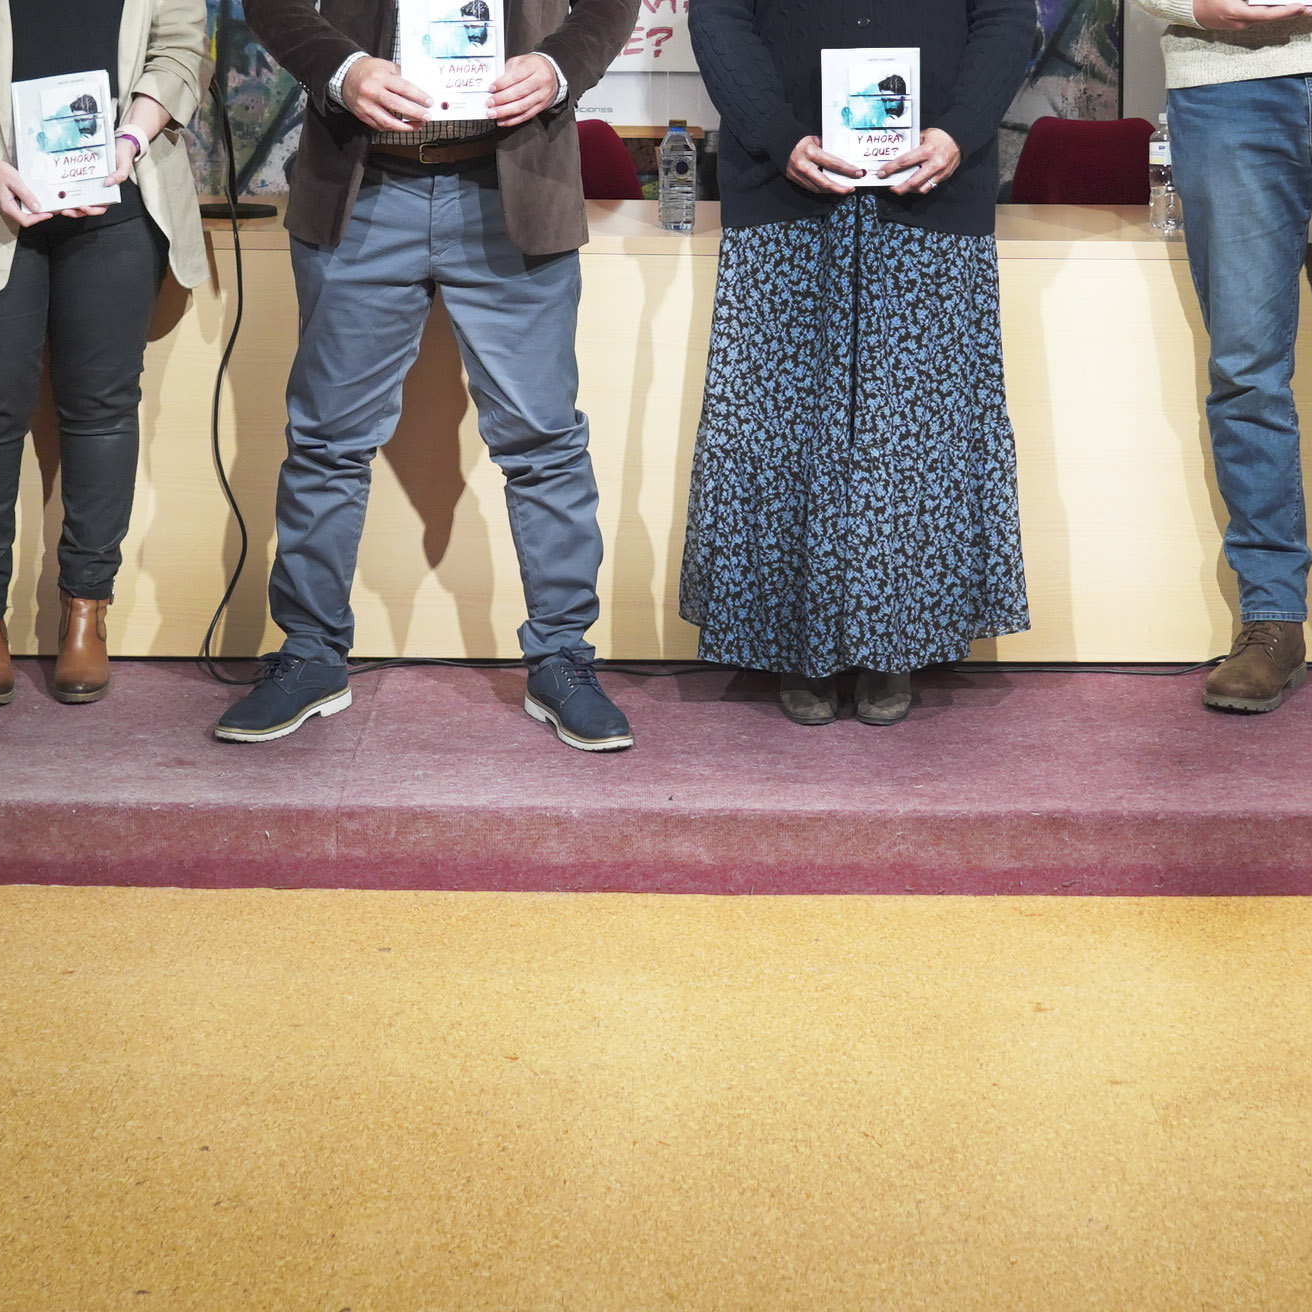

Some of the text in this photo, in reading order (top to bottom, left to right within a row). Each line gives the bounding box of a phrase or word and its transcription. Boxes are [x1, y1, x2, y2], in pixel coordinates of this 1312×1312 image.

[439, 65, 445, 74] Y
[858, 135, 863, 144] Y
[54, 158, 60, 167] Y
